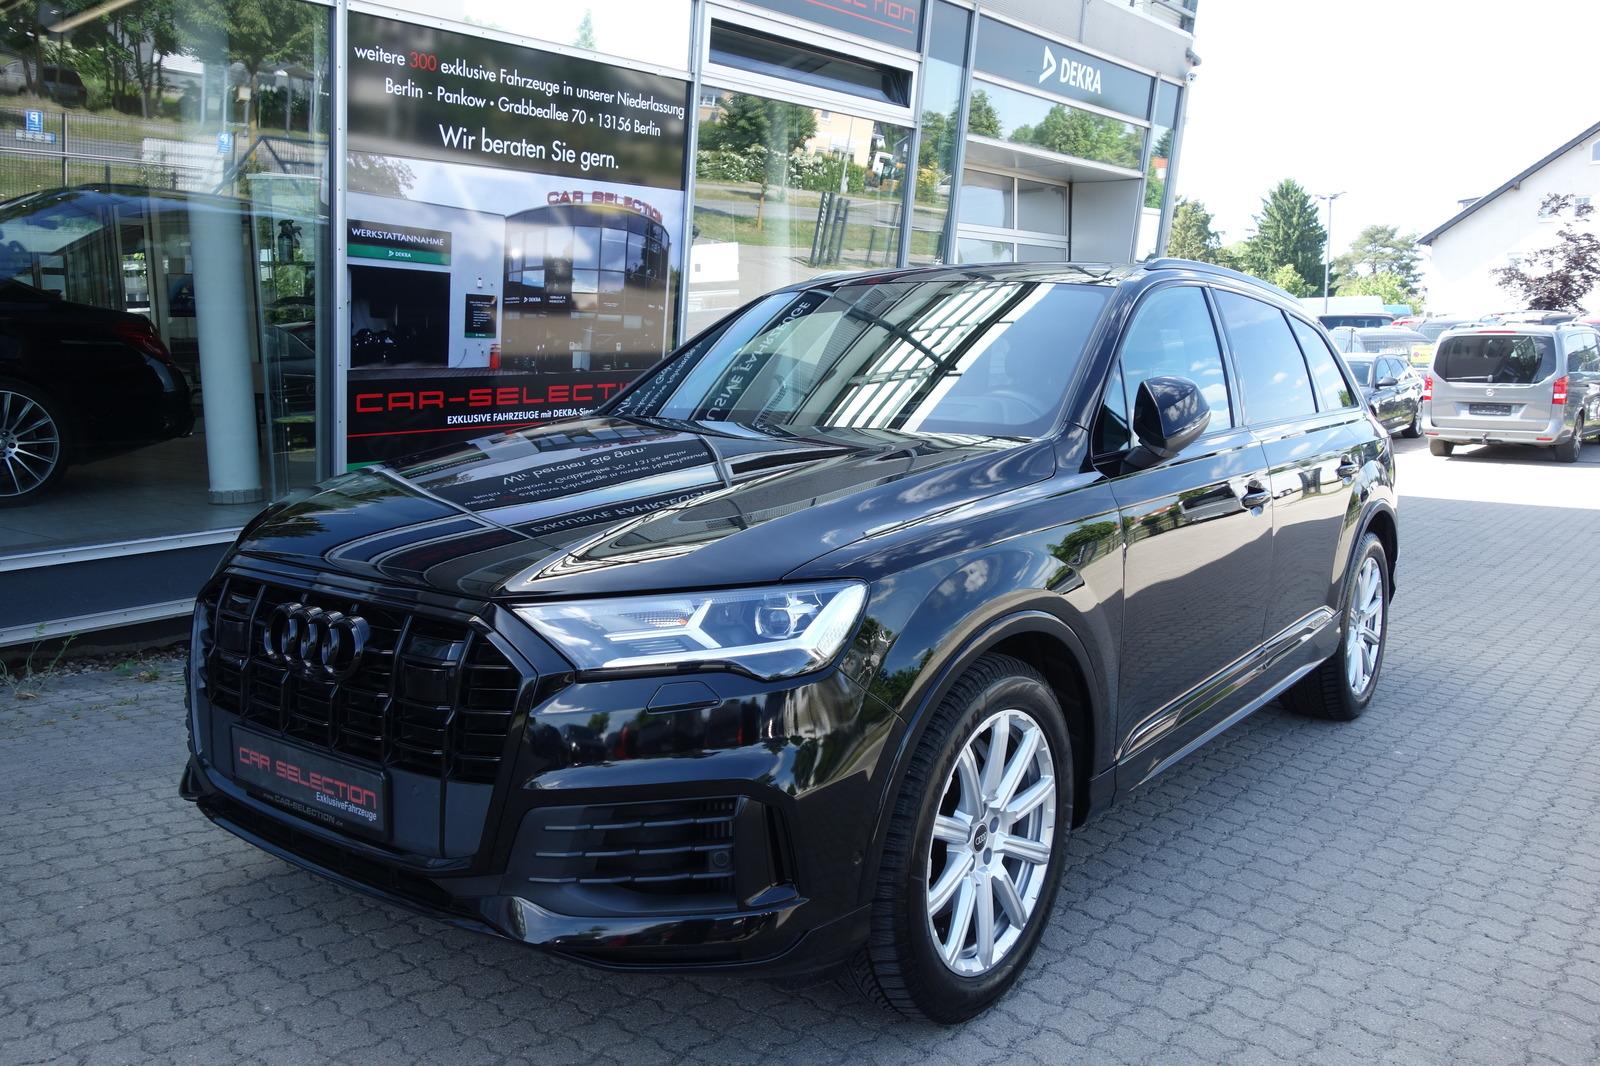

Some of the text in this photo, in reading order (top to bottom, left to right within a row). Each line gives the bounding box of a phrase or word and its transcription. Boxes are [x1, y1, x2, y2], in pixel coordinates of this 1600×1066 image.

[354, 45, 685, 119] weitere 300 exklusive Fahrzeuge in unserer Niederlassung
[1060, 57, 1102, 95] DEKRA
[385, 77, 423, 99] Berlin
[437, 86, 486, 108] Pankow
[498, 96, 568, 122] Grabbeallee
[571, 109, 587, 125] 70
[598, 113, 631, 131] 13156
[634, 119, 661, 137] Berlin
[439, 123, 620, 171] Wir beraten Sie gern.
[547, 190, 584, 205] CAR
[351, 227, 445, 246] WERKSTATTANNAHME
[354, 382, 631, 413] CAR-SELECTI
[447, 412, 492, 425] EXKLUSIVE
[493, 410, 540, 422] FAHRZEUGE
[540, 410, 552, 419] mit
[239, 746, 377, 810] CAR SELECTION
[316, 791, 377, 822] ExklusiveFahrzeuge
